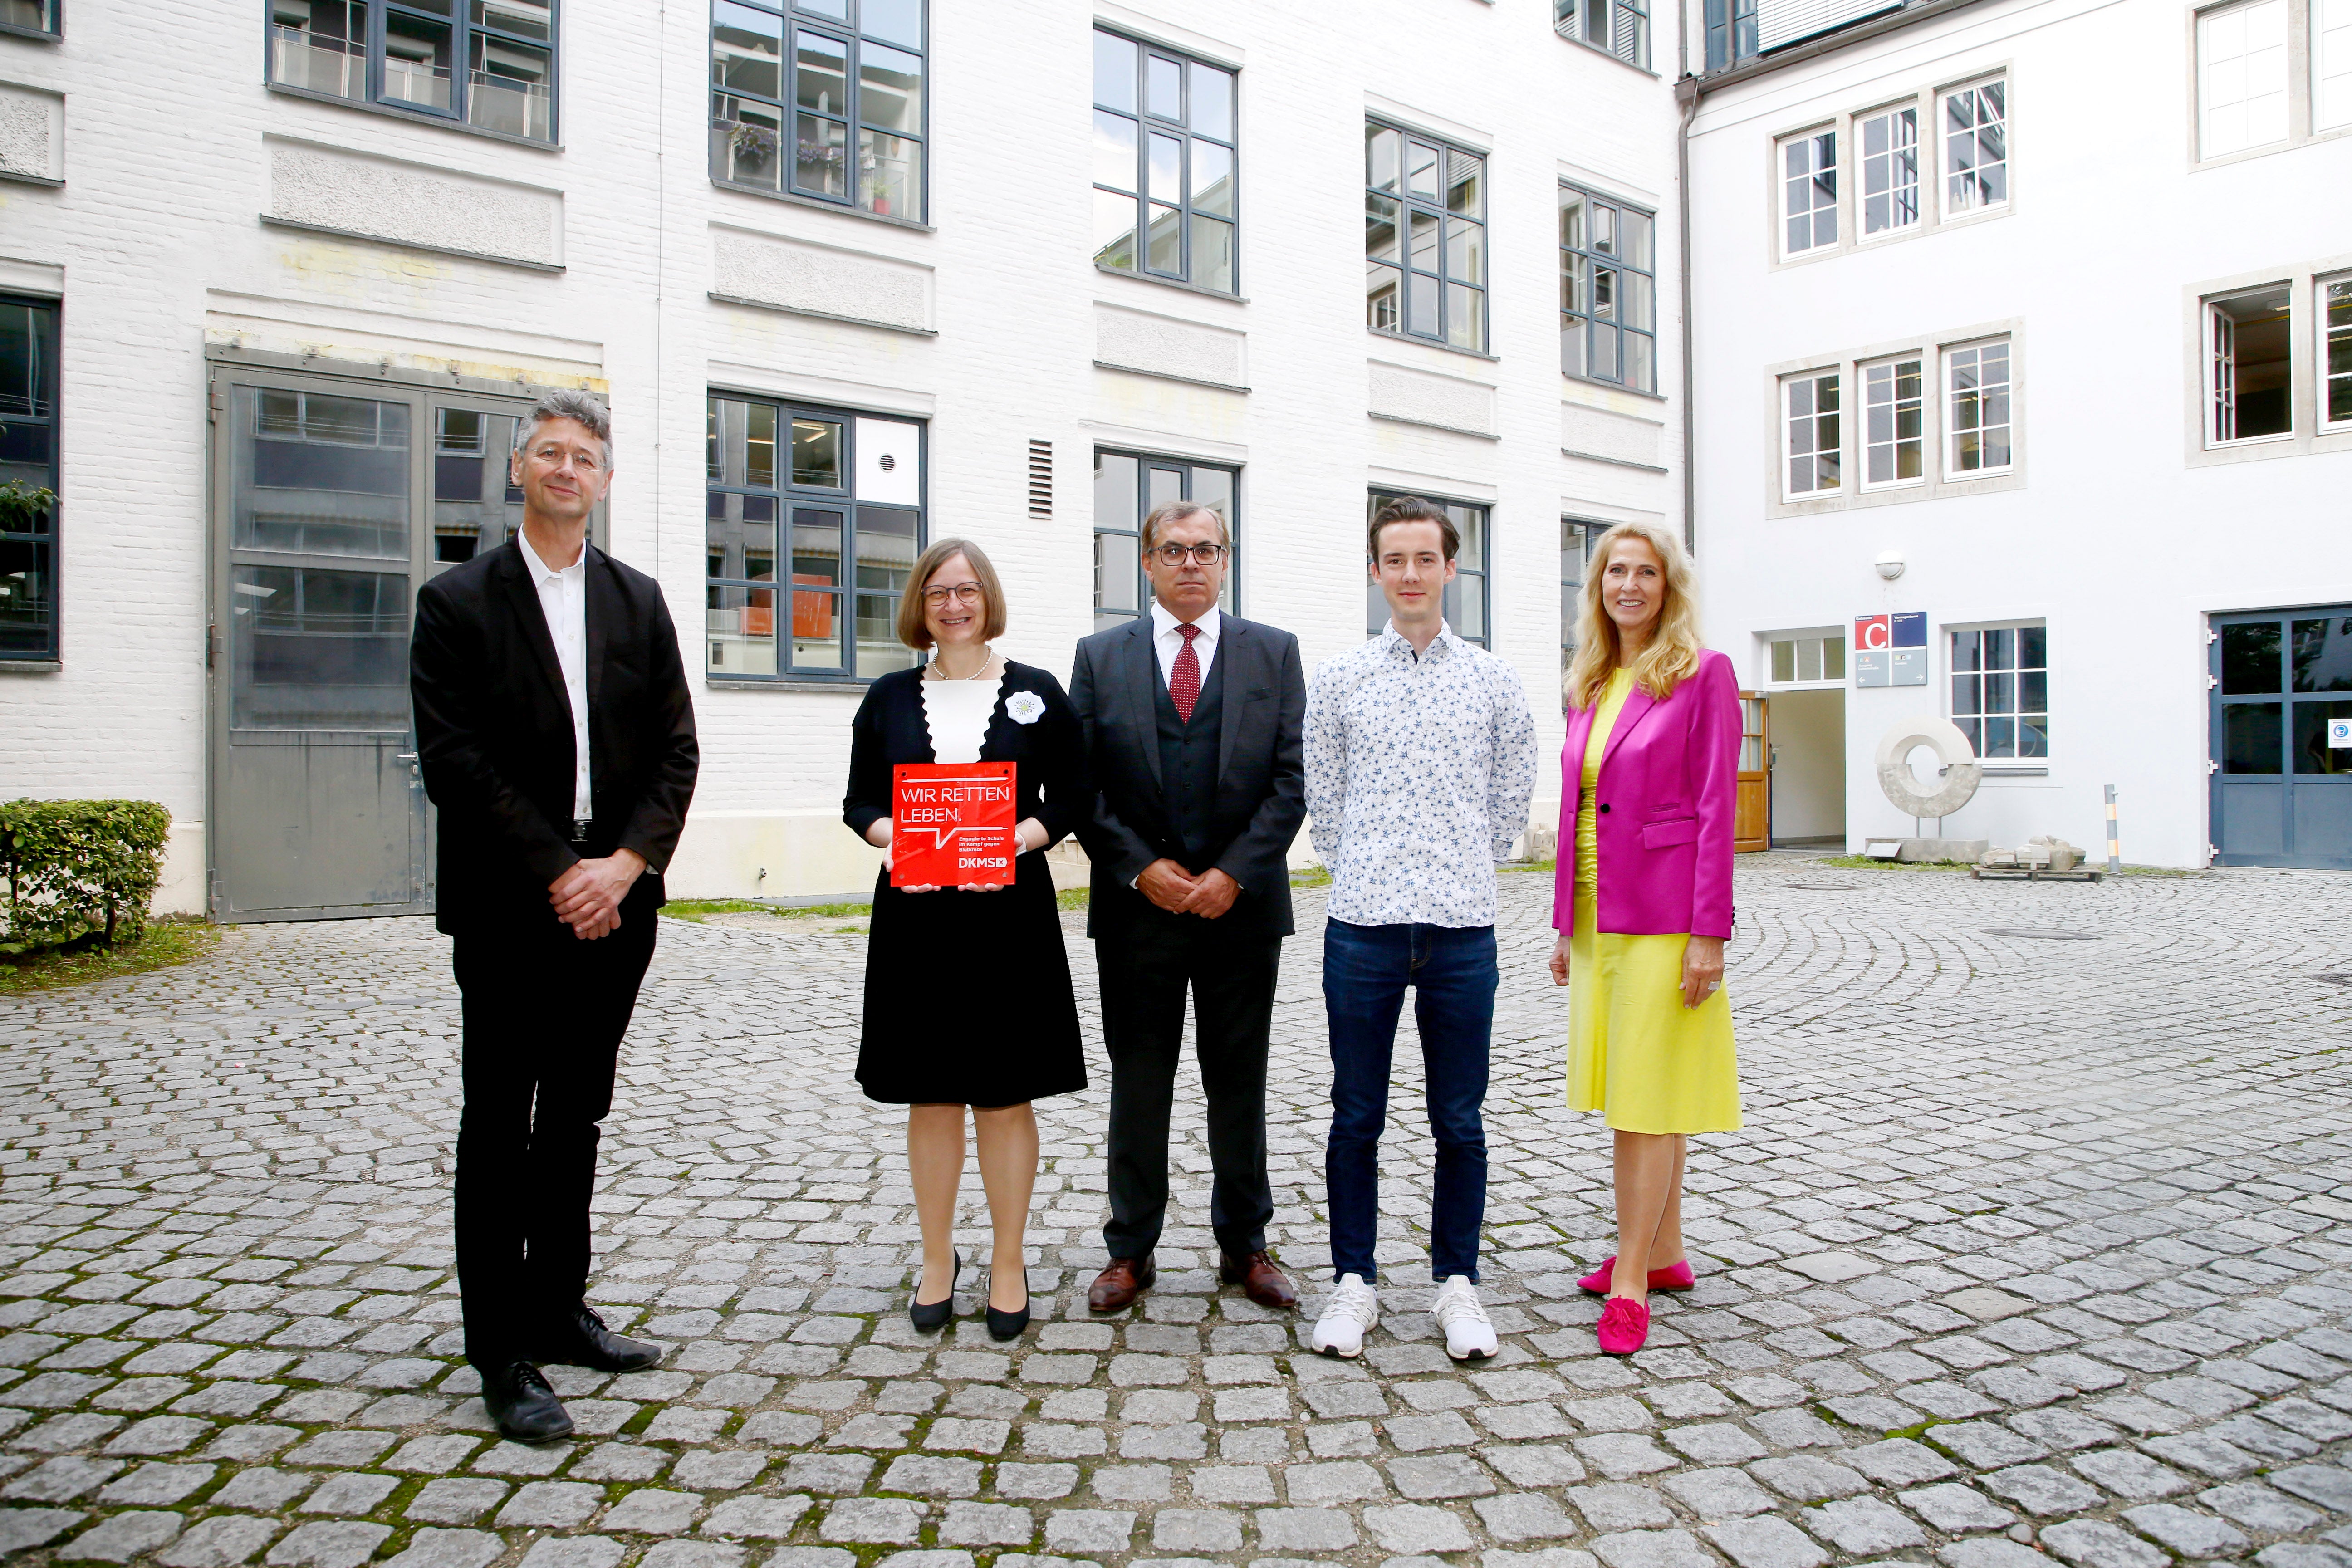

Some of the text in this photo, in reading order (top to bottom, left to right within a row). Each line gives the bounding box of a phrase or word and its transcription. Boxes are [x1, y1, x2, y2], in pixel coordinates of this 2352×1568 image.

[1865, 623, 1887, 649] C
[901, 786, 1009, 802] WIR RETTEN
[900, 807, 962, 823] LEBEN.
[959, 857, 995, 868] DKMS
